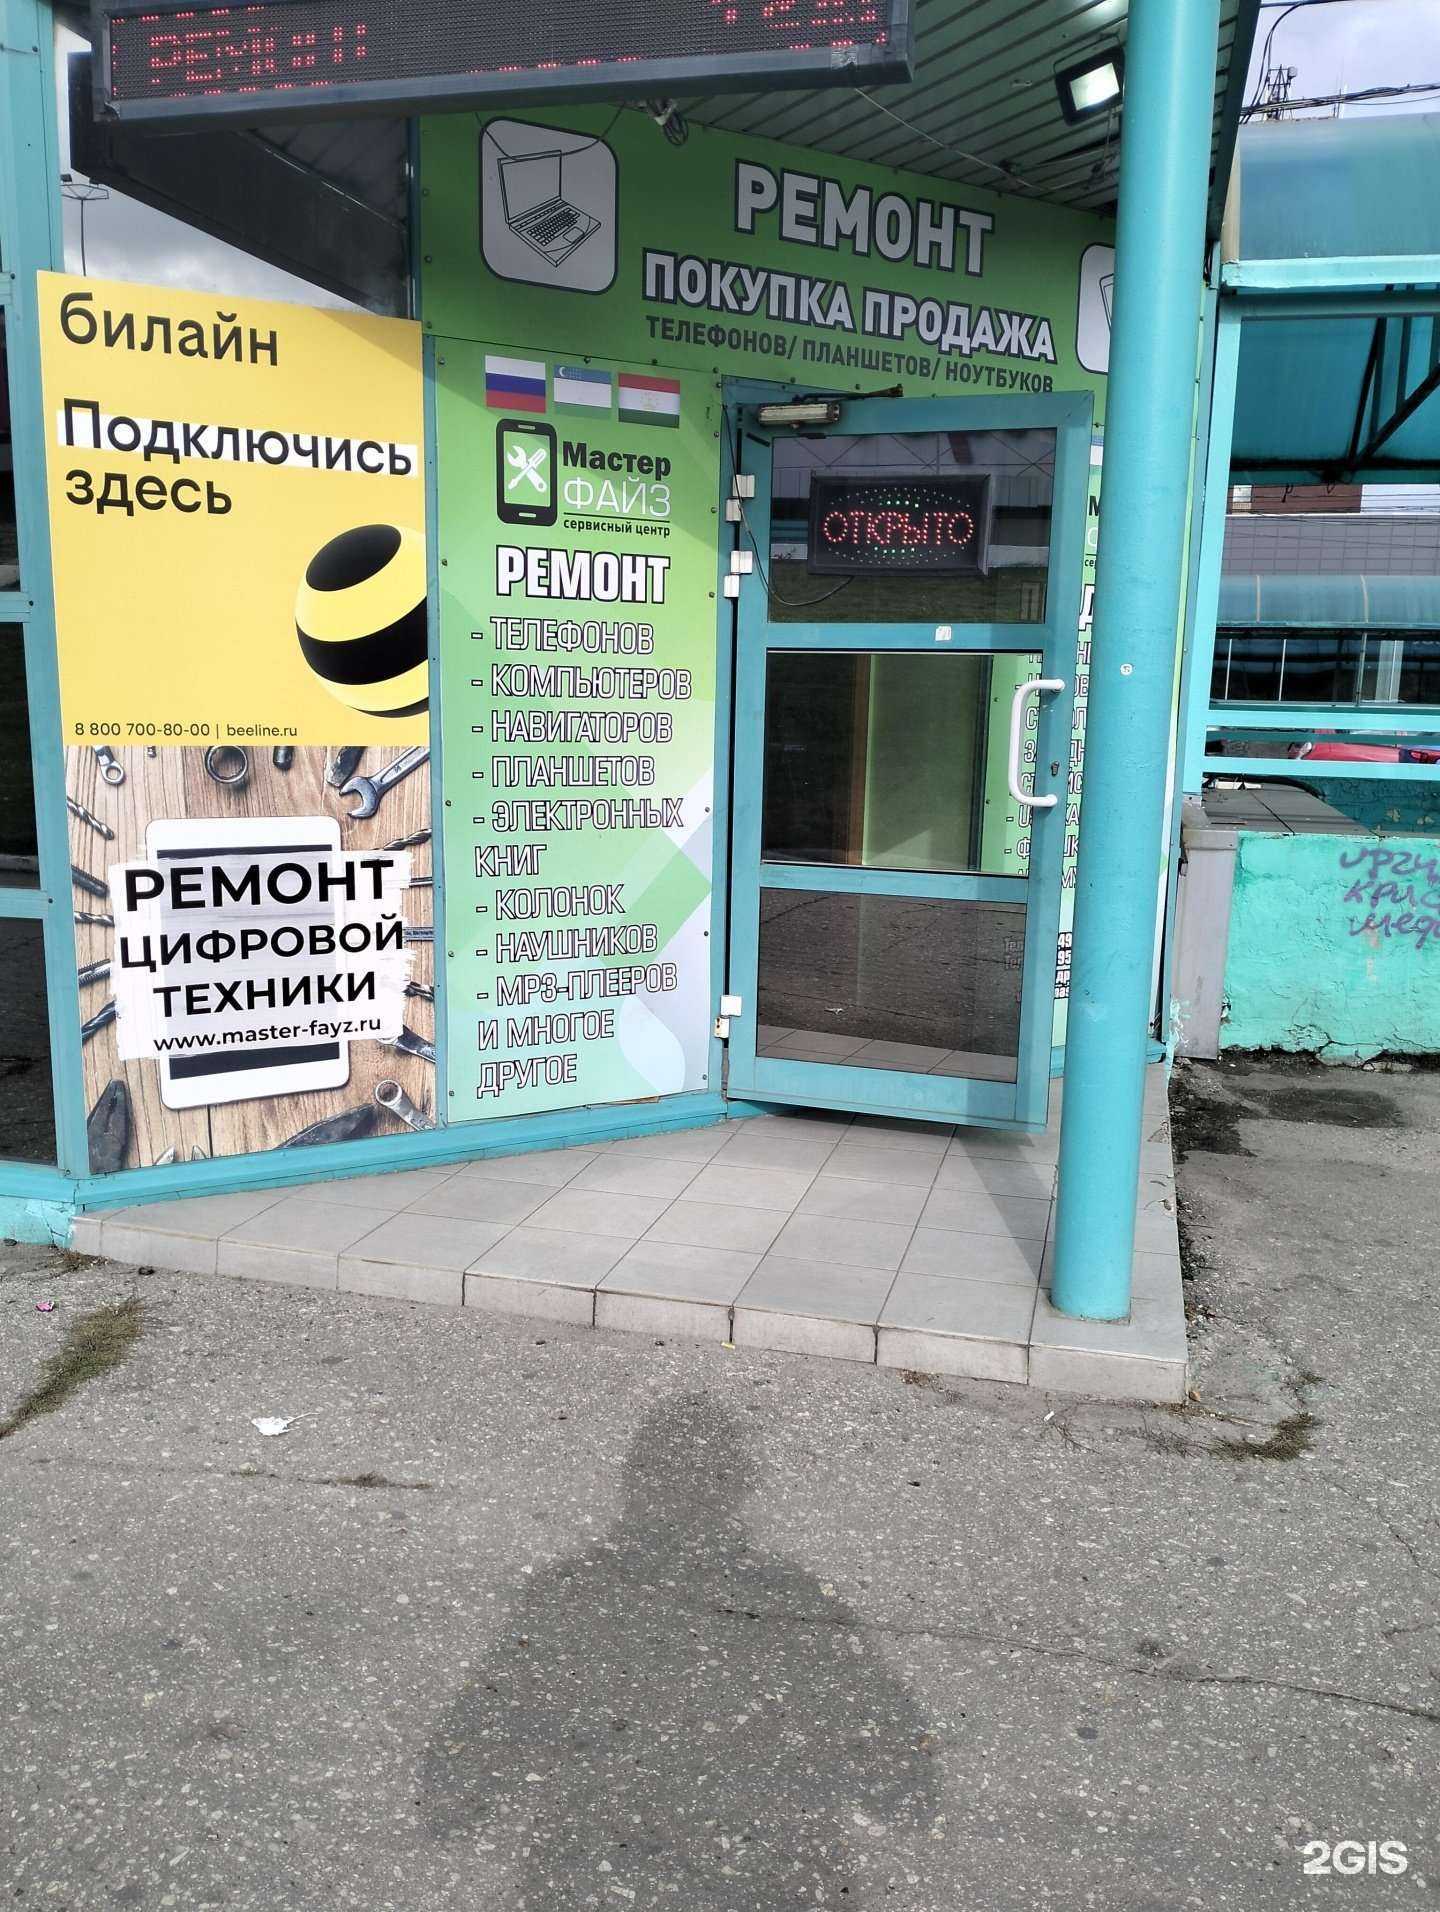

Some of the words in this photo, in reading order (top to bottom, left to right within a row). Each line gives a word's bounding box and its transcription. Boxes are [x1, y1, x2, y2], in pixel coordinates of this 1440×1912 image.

[735, 158, 994, 277] РЕМОНТ
[643, 247, 857, 334] ПОКУПКА
[861, 287, 1057, 364] ПРОДАЖА
[61, 292, 278, 366] билайн
[646, 315, 797, 360] ТЕЛЕФОНОВ/
[803, 339, 938, 381] ПЛАНШЕТОВ/
[945, 363, 1053, 393] НОУТБУКОВ
[64, 397, 412, 475] Подключись
[563, 441, 671, 481] Мастер
[66, 470, 232, 517] здесь
[563, 476, 671, 517] ФАЙЗ
[563, 519, 632, 534] сервисный
[635, 524, 671, 538] центр
[823, 511, 974, 544] ОТКРЫТО
[496, 545, 671, 604] РЕМОНТ
[490, 616, 654, 654] ТЕЛЕФОНОВ
[491, 664, 691, 699] КОМПЬЮТЕРОВ
[75, 723, 84, 736] 8
[90, 723, 121, 736] 800
[127, 723, 210, 736] 700-80-00
[227, 724, 297, 737] beeline.ru
[491, 710, 672, 742] НАВИГАТОРОВ
[492, 756, 655, 787] ПЛАНШЕТОВ
[492, 798, 683, 832] ЭЛЕКТРОННЫХ
[475, 845, 547, 877] КНИГ
[125, 859, 394, 912] РЕМОНТ
[496, 884, 625, 920] КОЛОНОК
[120, 913, 403, 973] ЦИФРОВОЙ
[496, 924, 657, 963] НАУШНИКОВ
[153, 972, 376, 1018] ТЕХНИКИ
[154, 1016, 381, 1051] www.master-fayz.ru
[478, 1020, 498, 1050] И
[507, 1009, 614, 1048] МНОГОЕ
[477, 1054, 577, 1099] ДРУГОЕ
